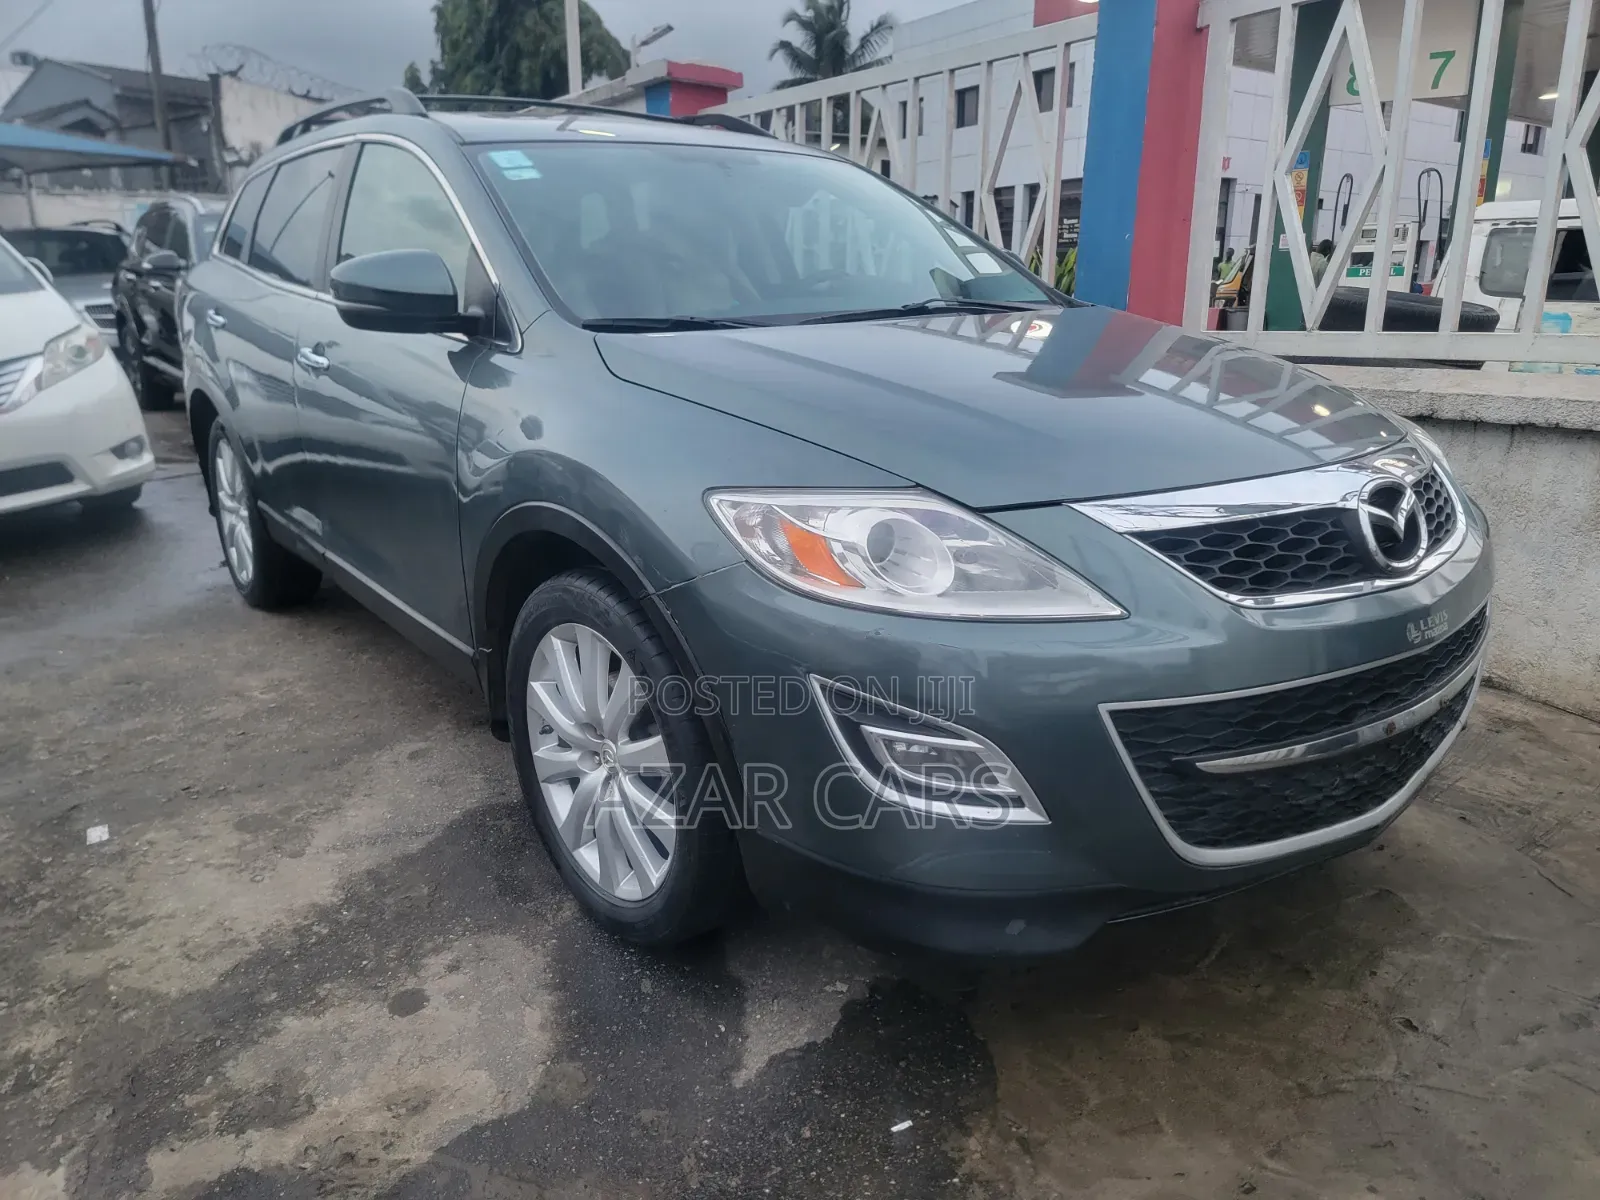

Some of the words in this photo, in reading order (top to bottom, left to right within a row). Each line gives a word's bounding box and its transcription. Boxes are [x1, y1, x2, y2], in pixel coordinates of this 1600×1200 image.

[1429, 50, 1456, 90] 7
[1359, 268, 1396, 276] PEL
[1420, 609, 1448, 630] LEVIS
